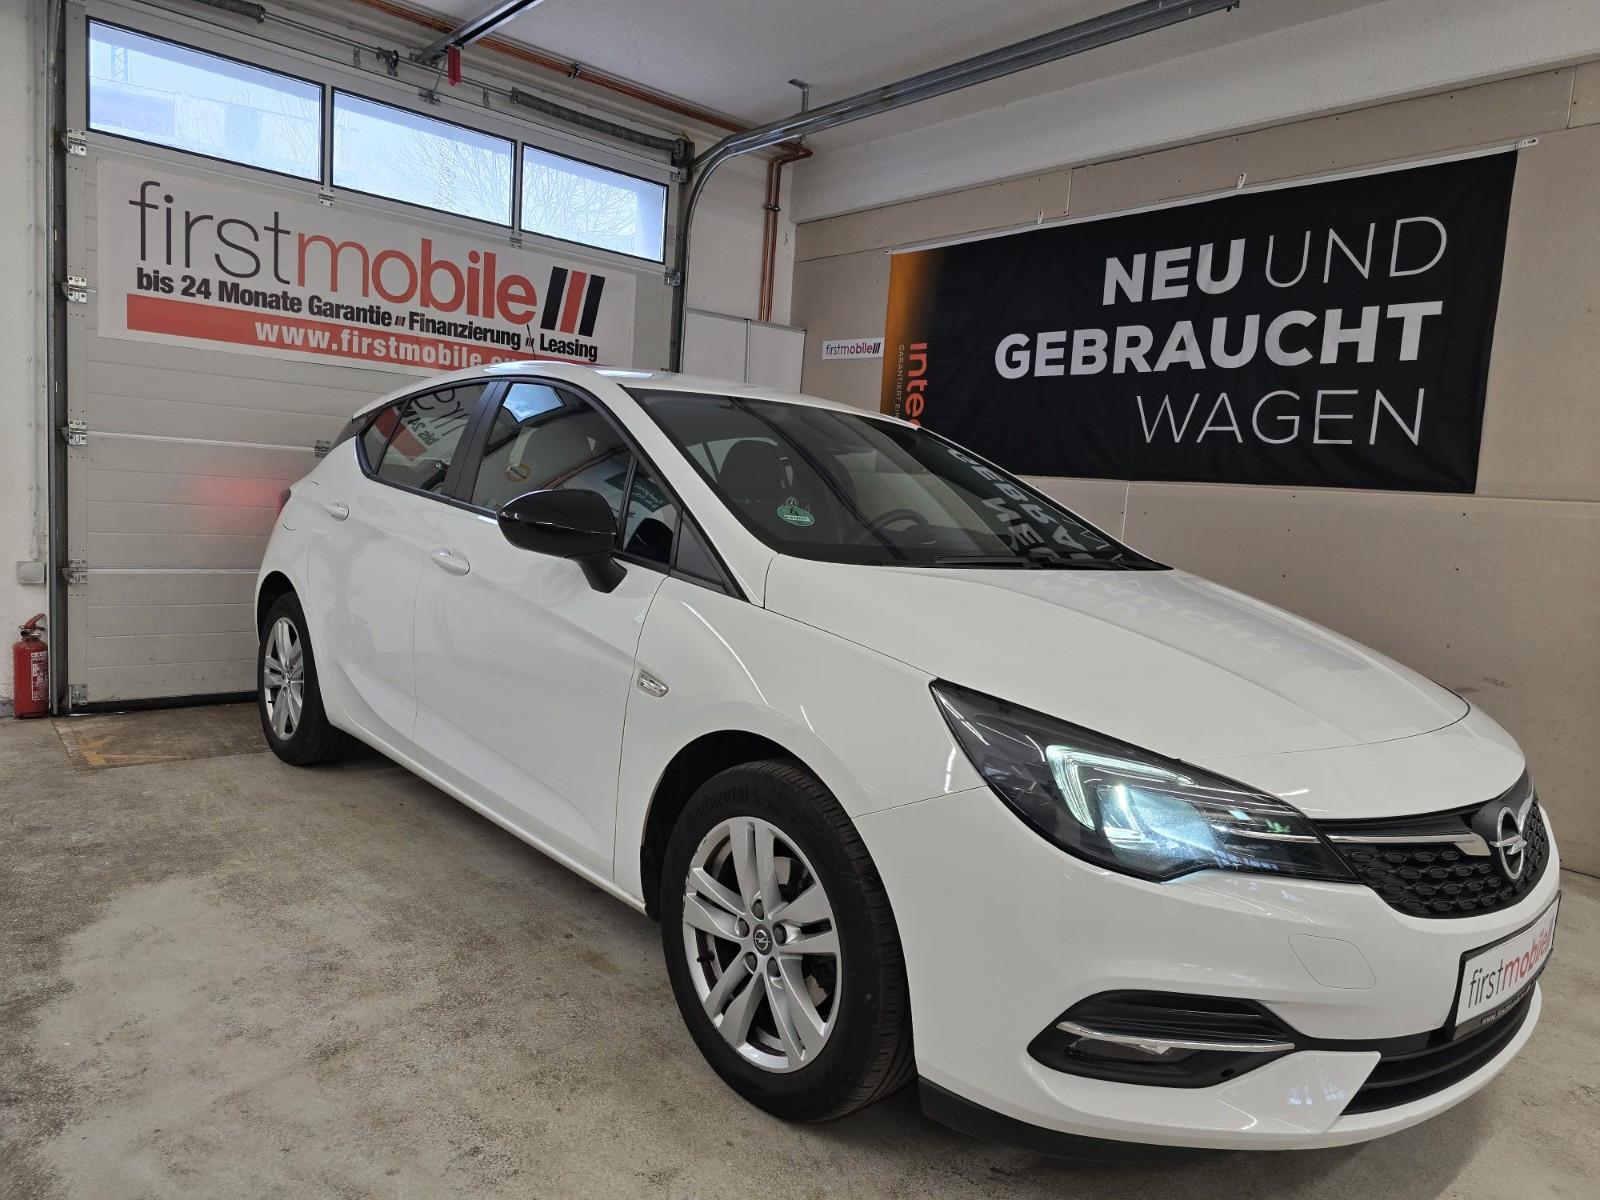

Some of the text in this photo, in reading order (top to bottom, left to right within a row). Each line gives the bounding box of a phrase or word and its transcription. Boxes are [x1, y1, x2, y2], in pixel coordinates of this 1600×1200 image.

[129, 180, 537, 325] firstmobile
[1103, 216, 1447, 306] NEU UND
[137, 267, 598, 362] bis 24 Monate Garantie Finanzierung Leasing
[826, 342, 873, 356] firstmobile
[995, 301, 1443, 379] GEBRAUCHT
[1136, 388, 1425, 446] WAGEN
